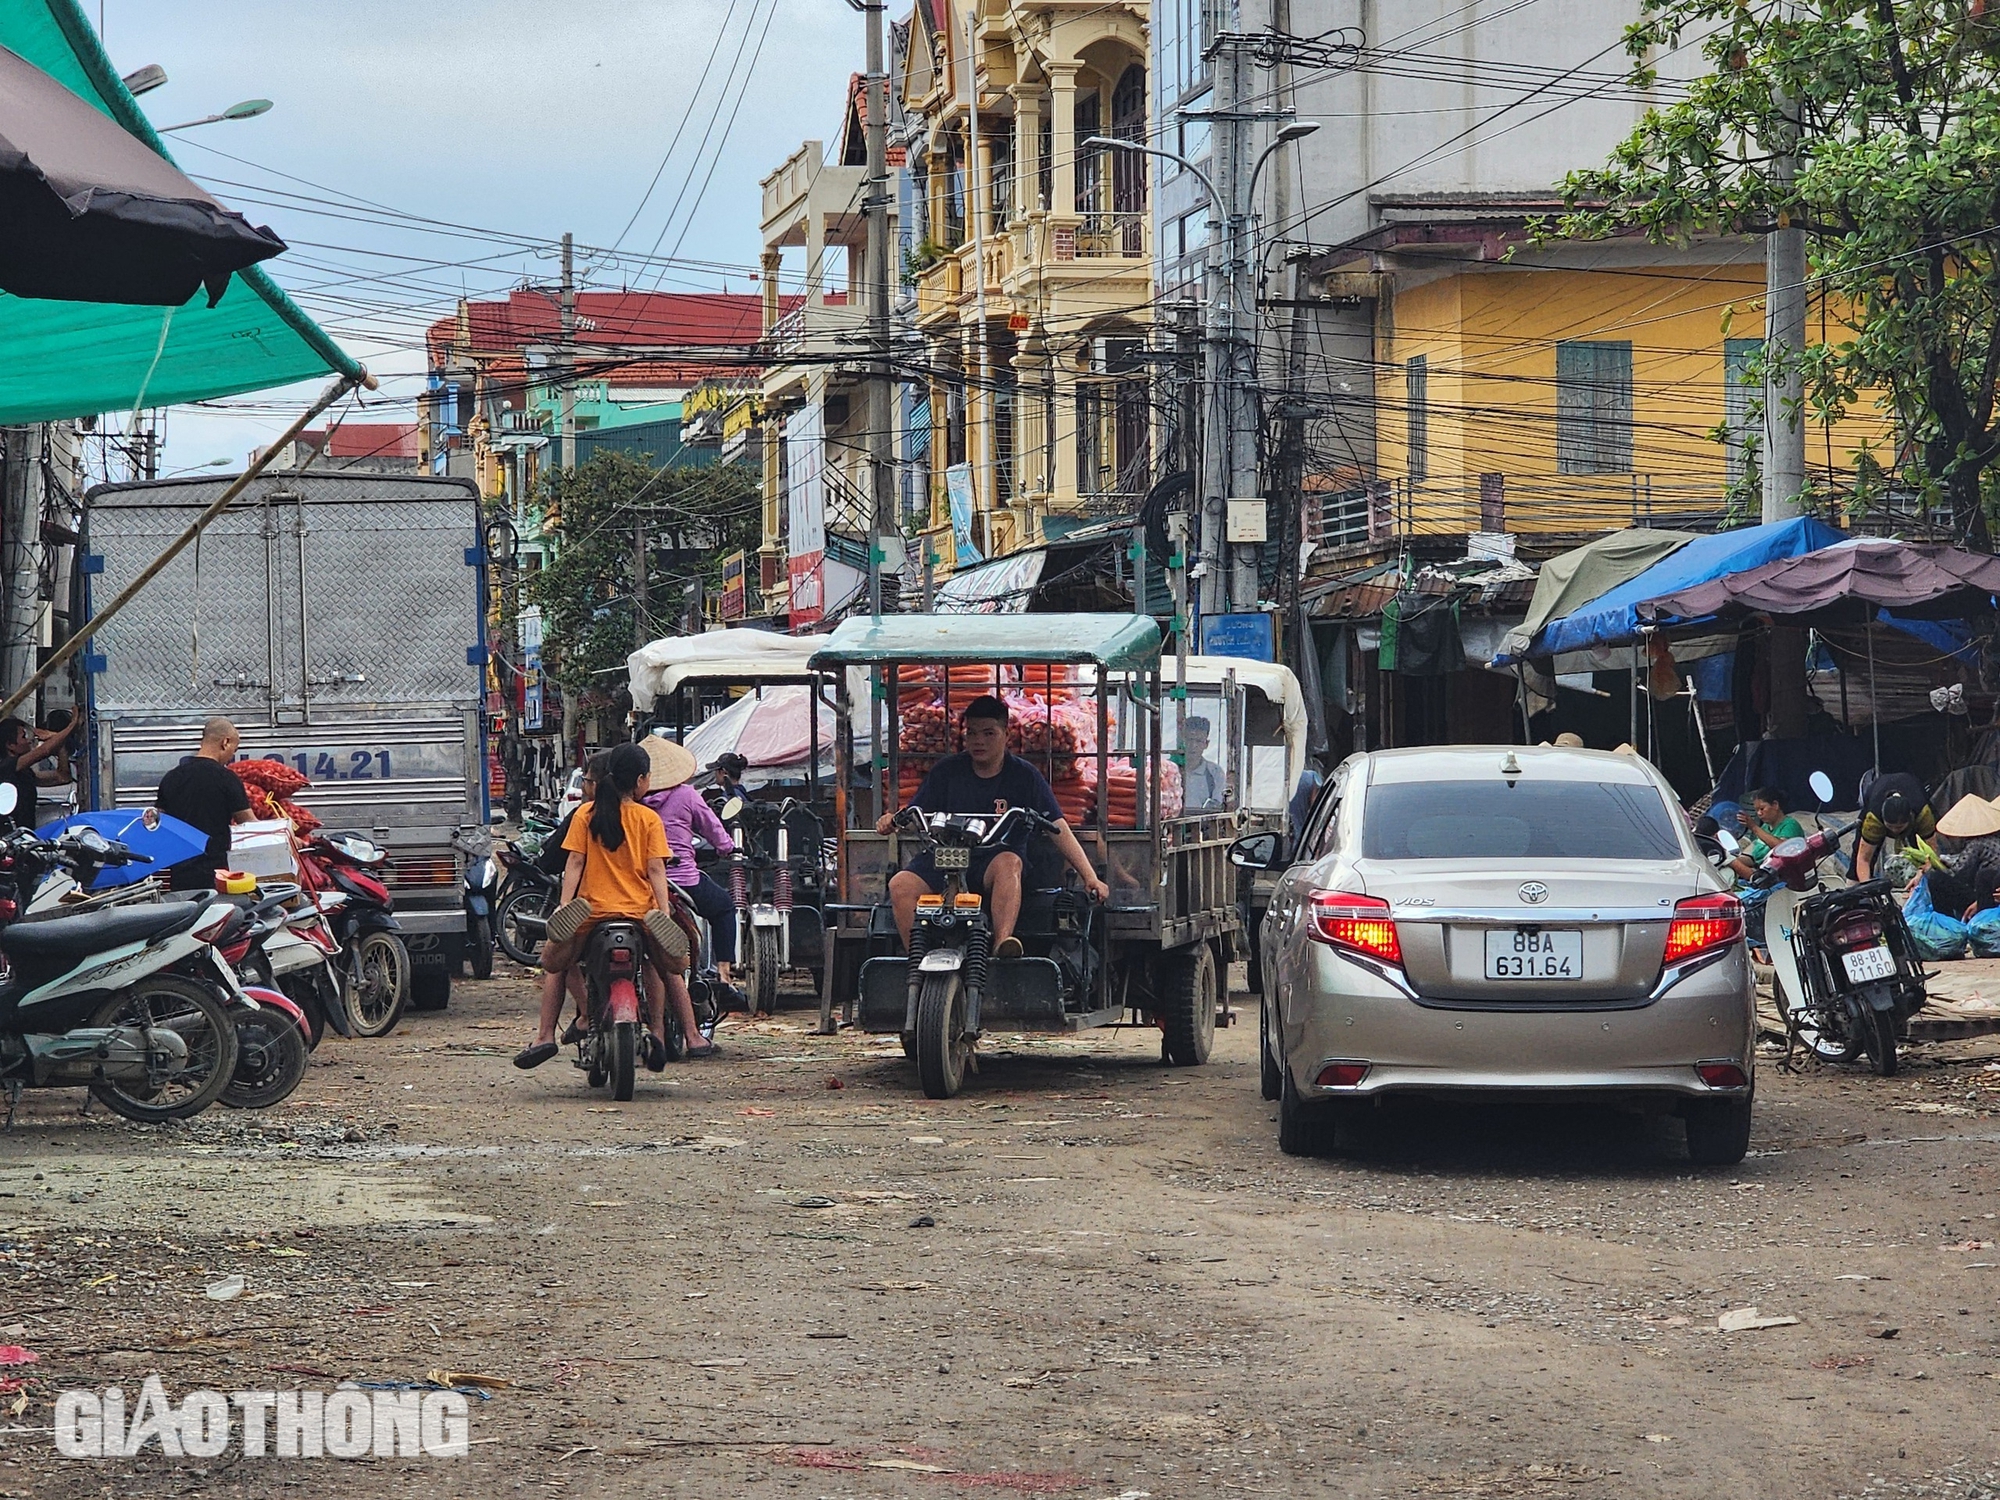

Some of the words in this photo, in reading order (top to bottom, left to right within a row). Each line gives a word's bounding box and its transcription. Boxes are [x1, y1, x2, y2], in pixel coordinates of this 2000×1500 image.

[1393, 897, 1435, 906] VIOS
[1657, 897, 1671, 906] G
[1513, 933, 1554, 953] 88A
[1496, 956, 1571, 976] 631.64
[1850, 949, 1883, 967] 88-B1
[1850, 961, 1893, 982] 211.60
